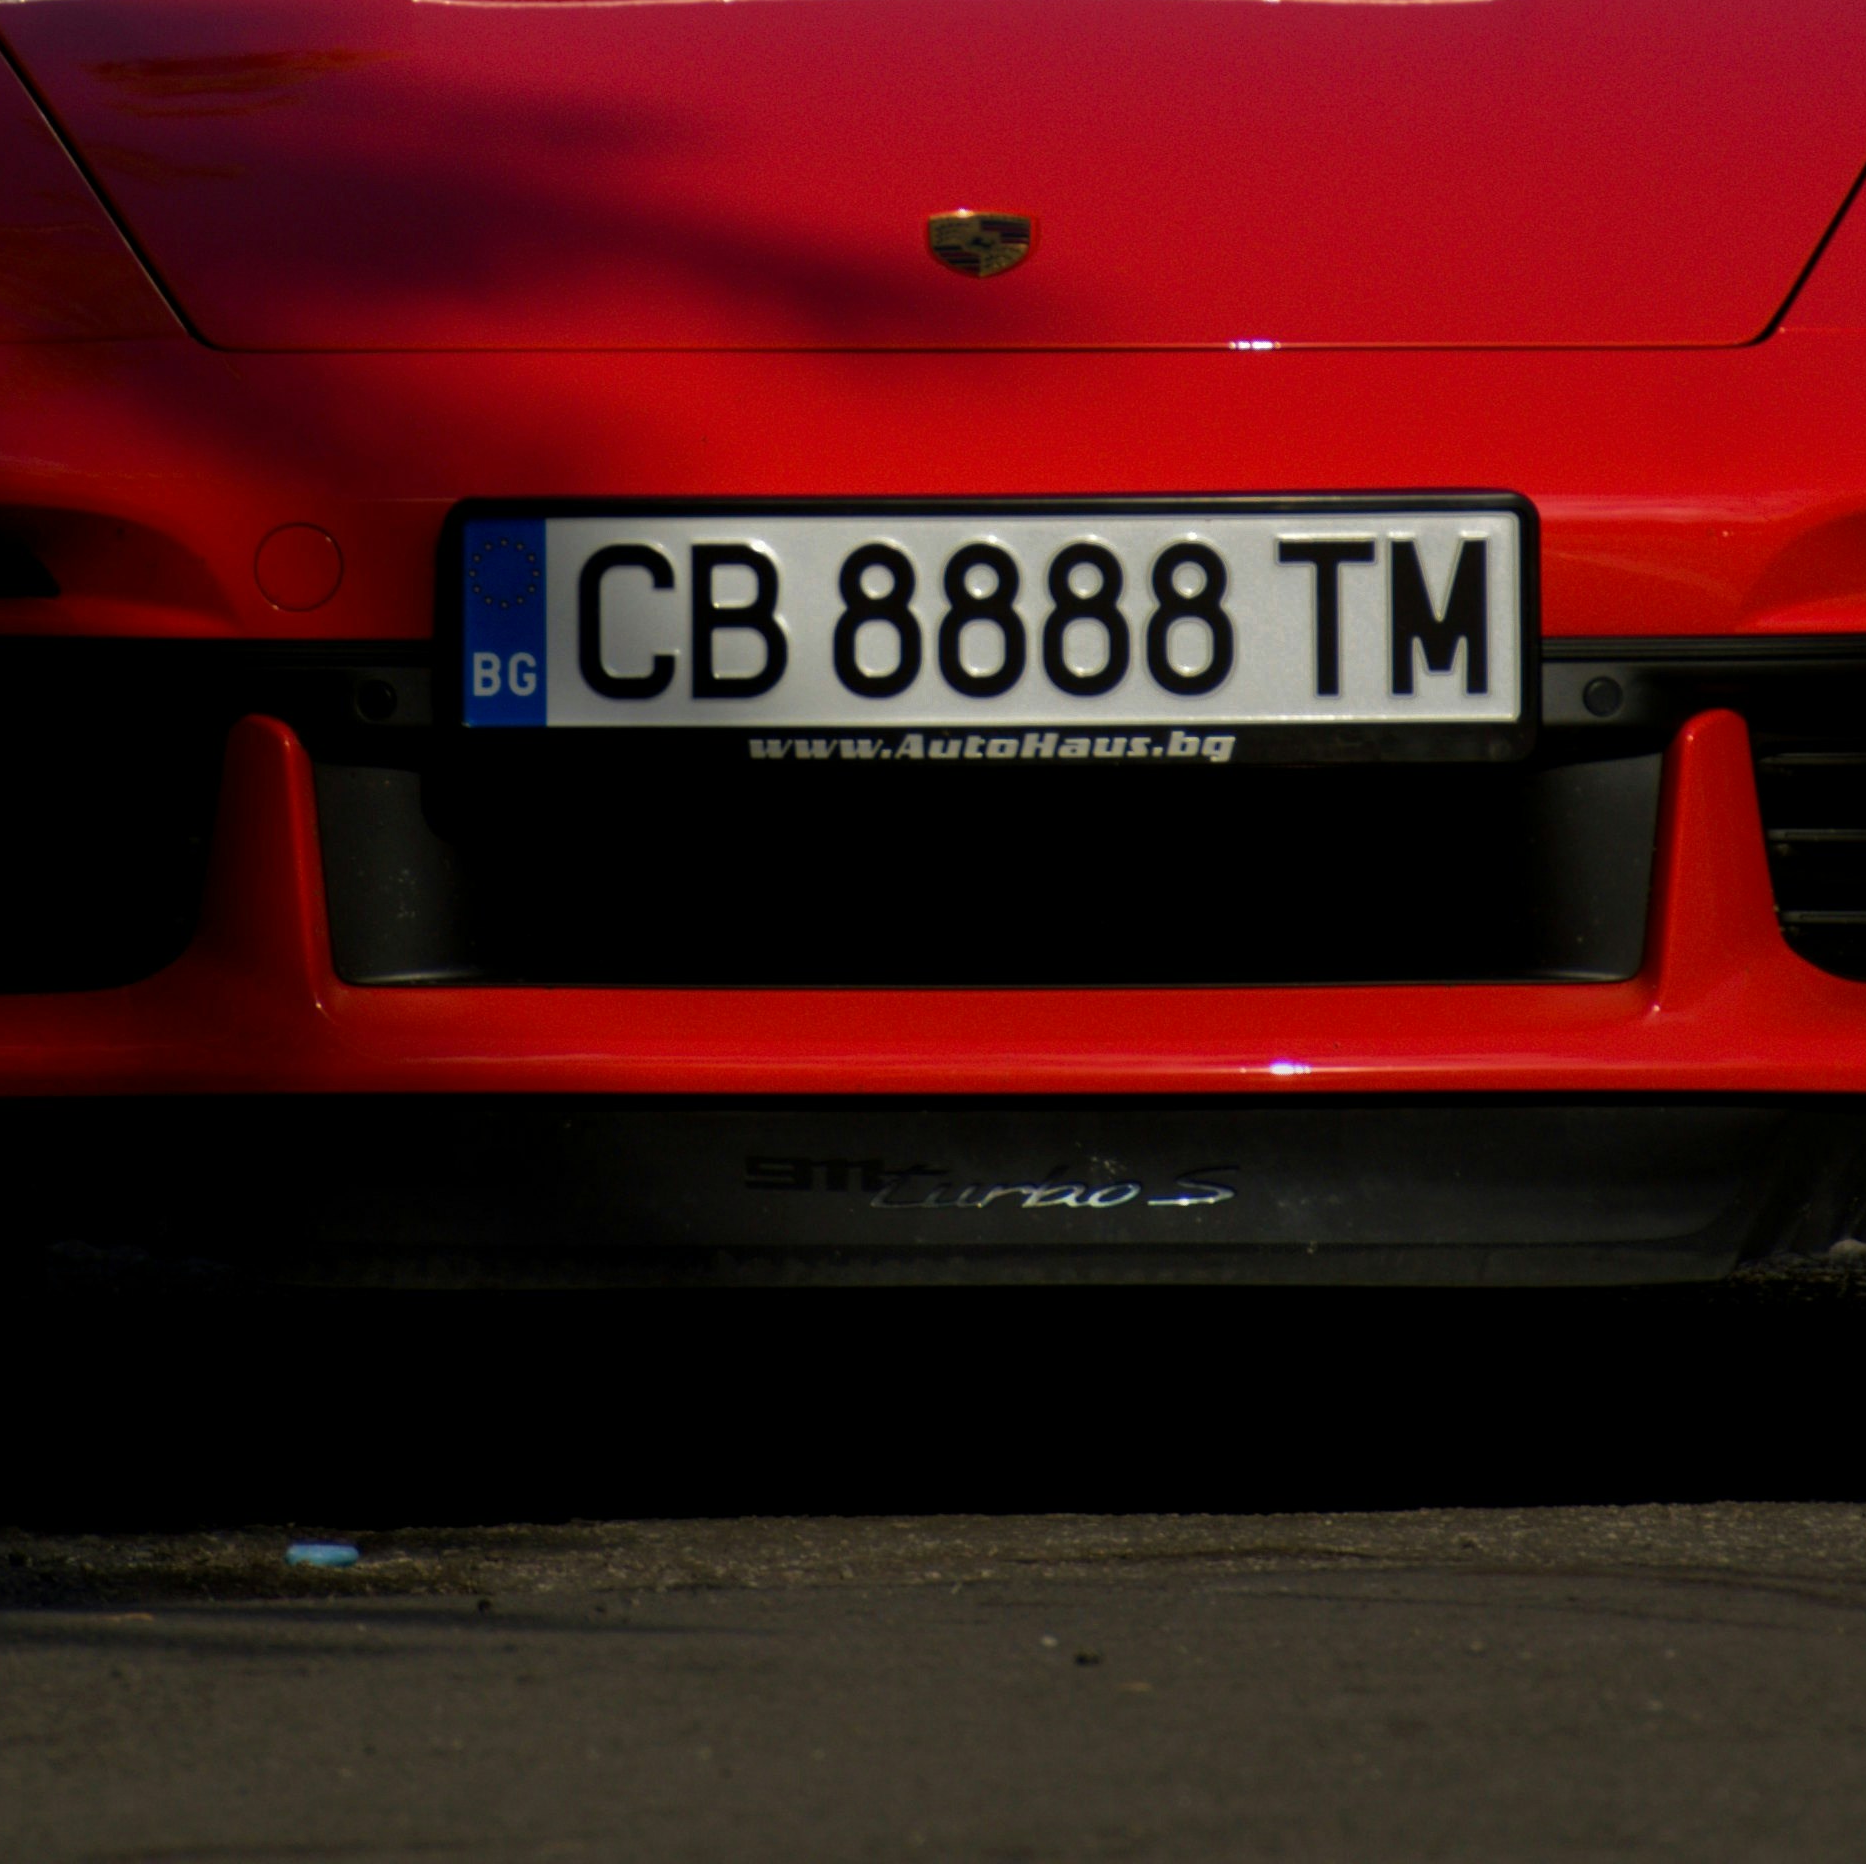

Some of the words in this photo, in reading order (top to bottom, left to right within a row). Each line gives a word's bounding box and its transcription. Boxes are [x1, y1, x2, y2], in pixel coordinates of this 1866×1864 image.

[576, 540, 788, 701] CB
[832, 539, 1236, 698] 8888
[1278, 537, 1489, 697] TM
[472, 652, 538, 697] BG
[748, 731, 1236, 763] www.AutoHaus.bg
[870, 1164, 1142, 1209] turbo
[1146, 1164, 1240, 1207] S
